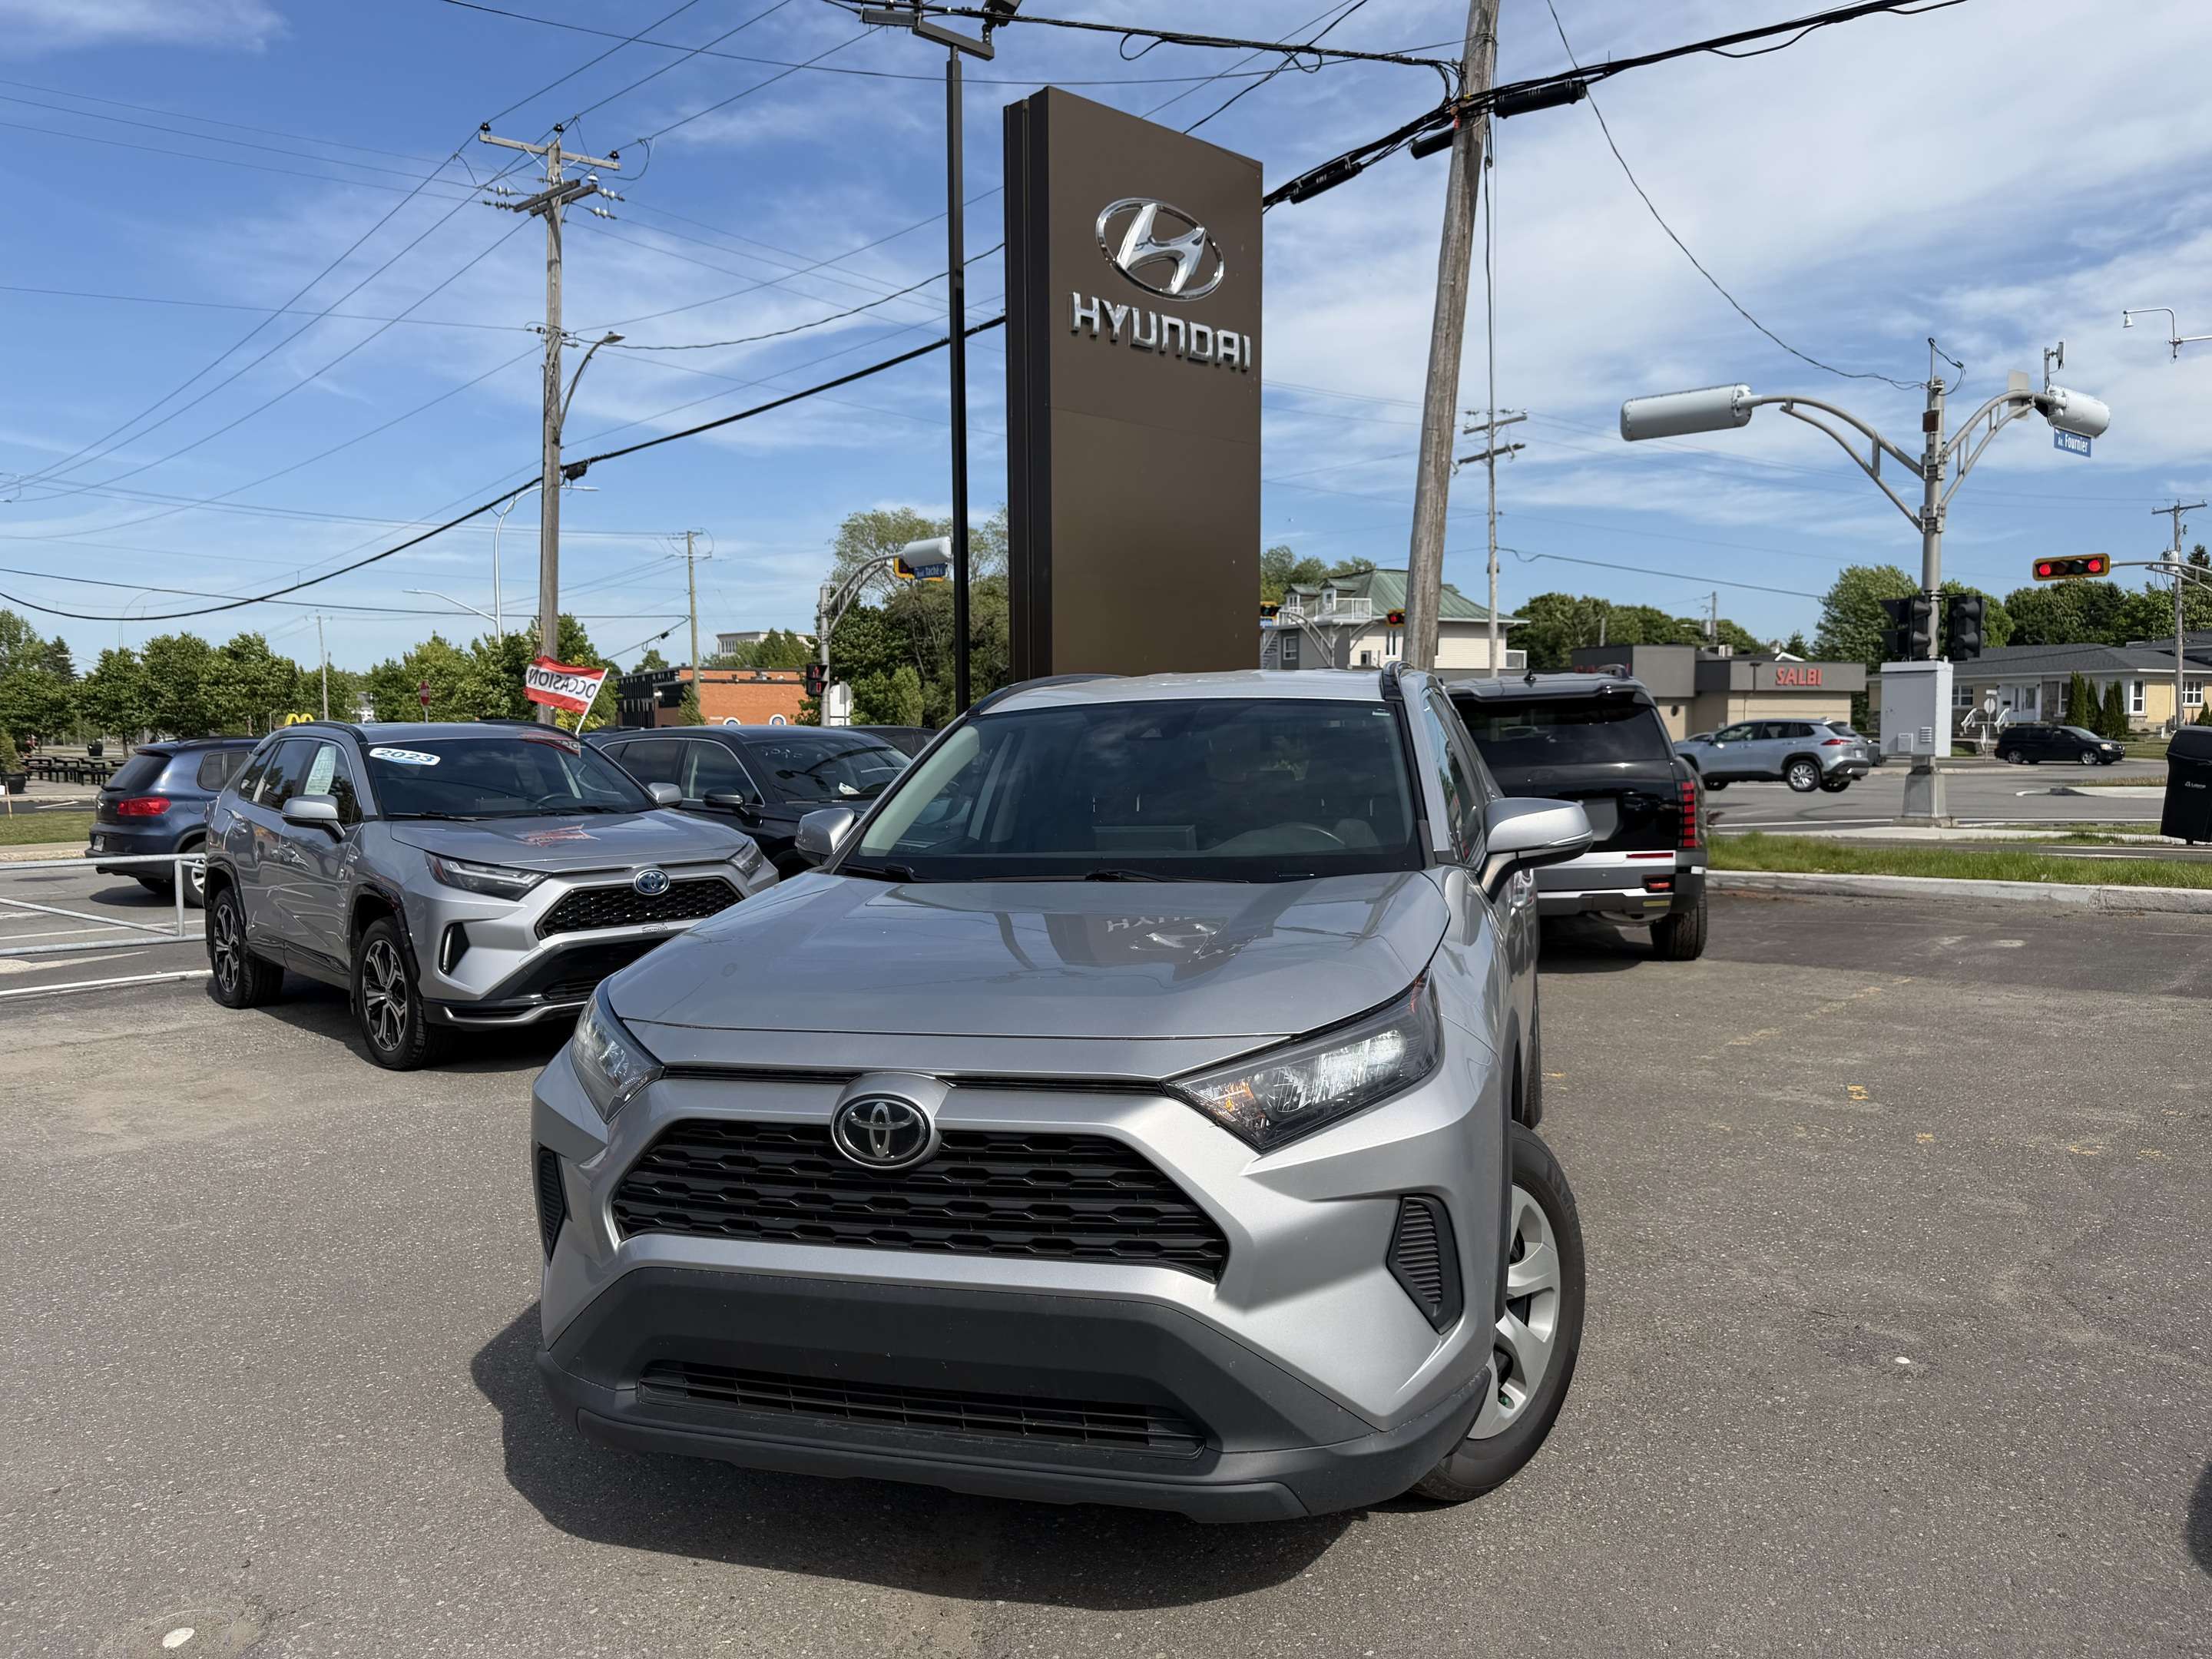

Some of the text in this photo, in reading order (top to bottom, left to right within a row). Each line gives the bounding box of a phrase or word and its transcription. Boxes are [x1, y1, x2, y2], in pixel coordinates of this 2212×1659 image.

[1071, 291, 1251, 371] HYUNDAI
[2065, 433, 2088, 453] Fournier
[1776, 666, 1823, 686] SALBI
[374, 749, 435, 762] 2023
